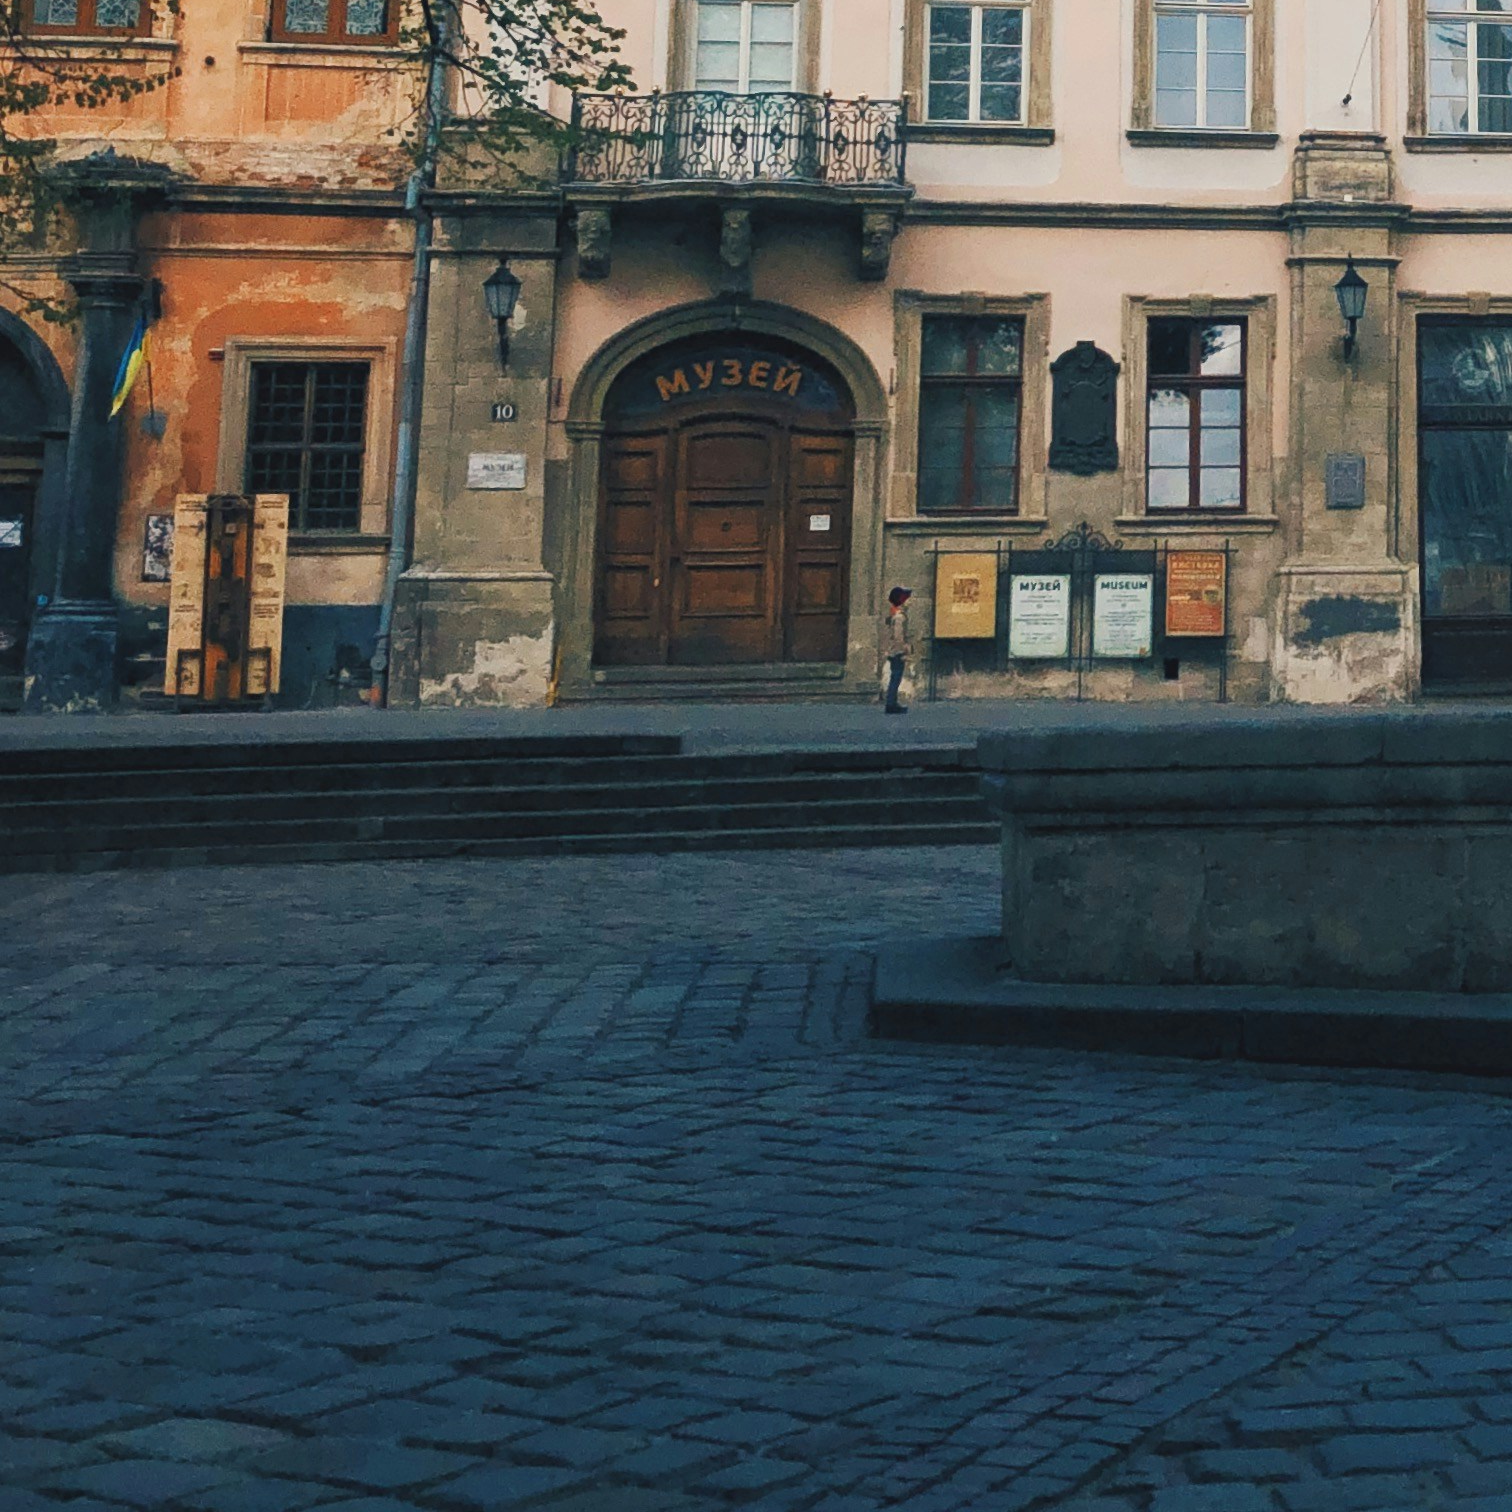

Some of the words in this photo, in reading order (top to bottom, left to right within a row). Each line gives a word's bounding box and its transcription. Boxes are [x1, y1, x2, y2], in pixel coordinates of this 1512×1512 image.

[655, 358, 803, 401] МУЗЕЙ
[495, 404, 514, 419] 10
[1019, 579, 1061, 592] МУЗЕЙ
[1101, 580, 1148, 590] MUSEUM
